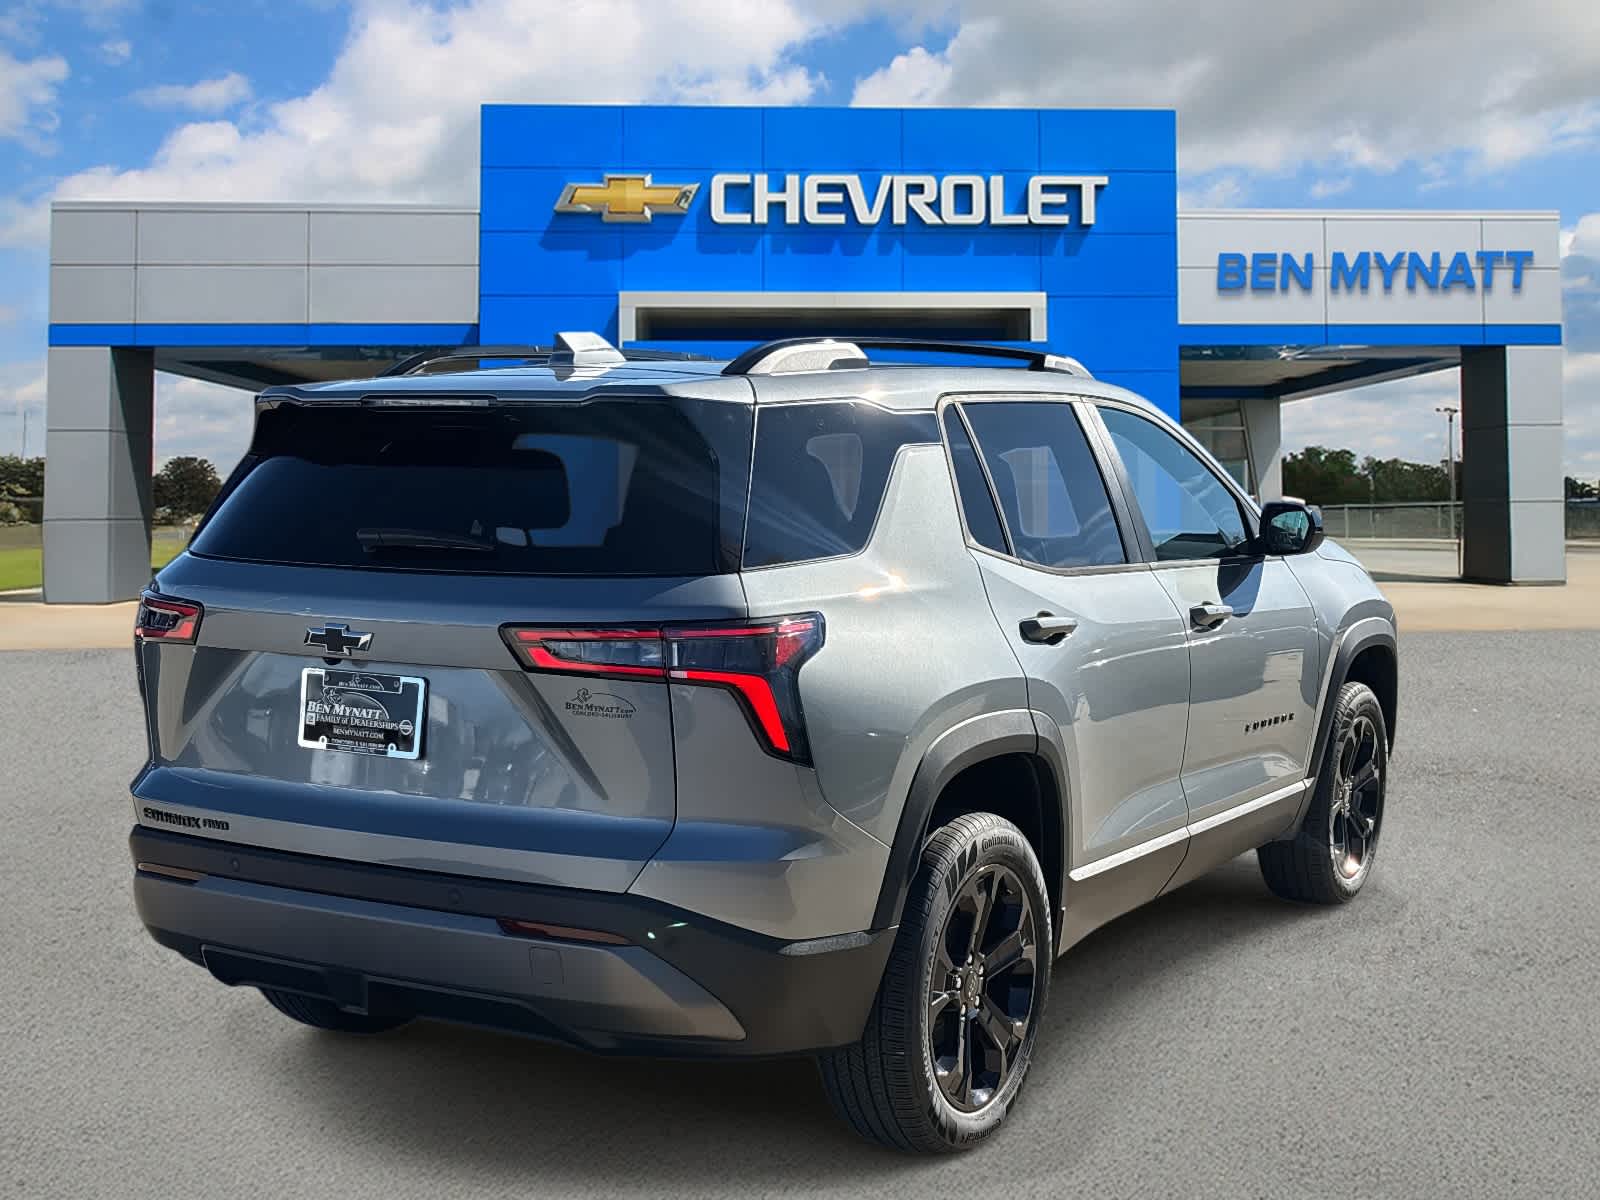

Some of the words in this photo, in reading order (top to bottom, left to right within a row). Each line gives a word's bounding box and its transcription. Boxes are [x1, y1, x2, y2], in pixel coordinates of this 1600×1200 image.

[711, 173, 1109, 225] CHEVROLET
[1217, 252, 1313, 291] BEN
[1329, 250, 1534, 290] MYNATT
[307, 701, 332, 714] BEN
[333, 704, 382, 720] MYNATT
[565, 702, 583, 710] BEN
[316, 713, 341, 724] FAMILY
[341, 717, 350, 725] of
[350, 717, 399, 730] DEALERSHIPS
[333, 727, 385, 740] BENMYNATT.COM
[143, 807, 201, 828] EQUINOX
[981, 834, 1015, 852] Continental
